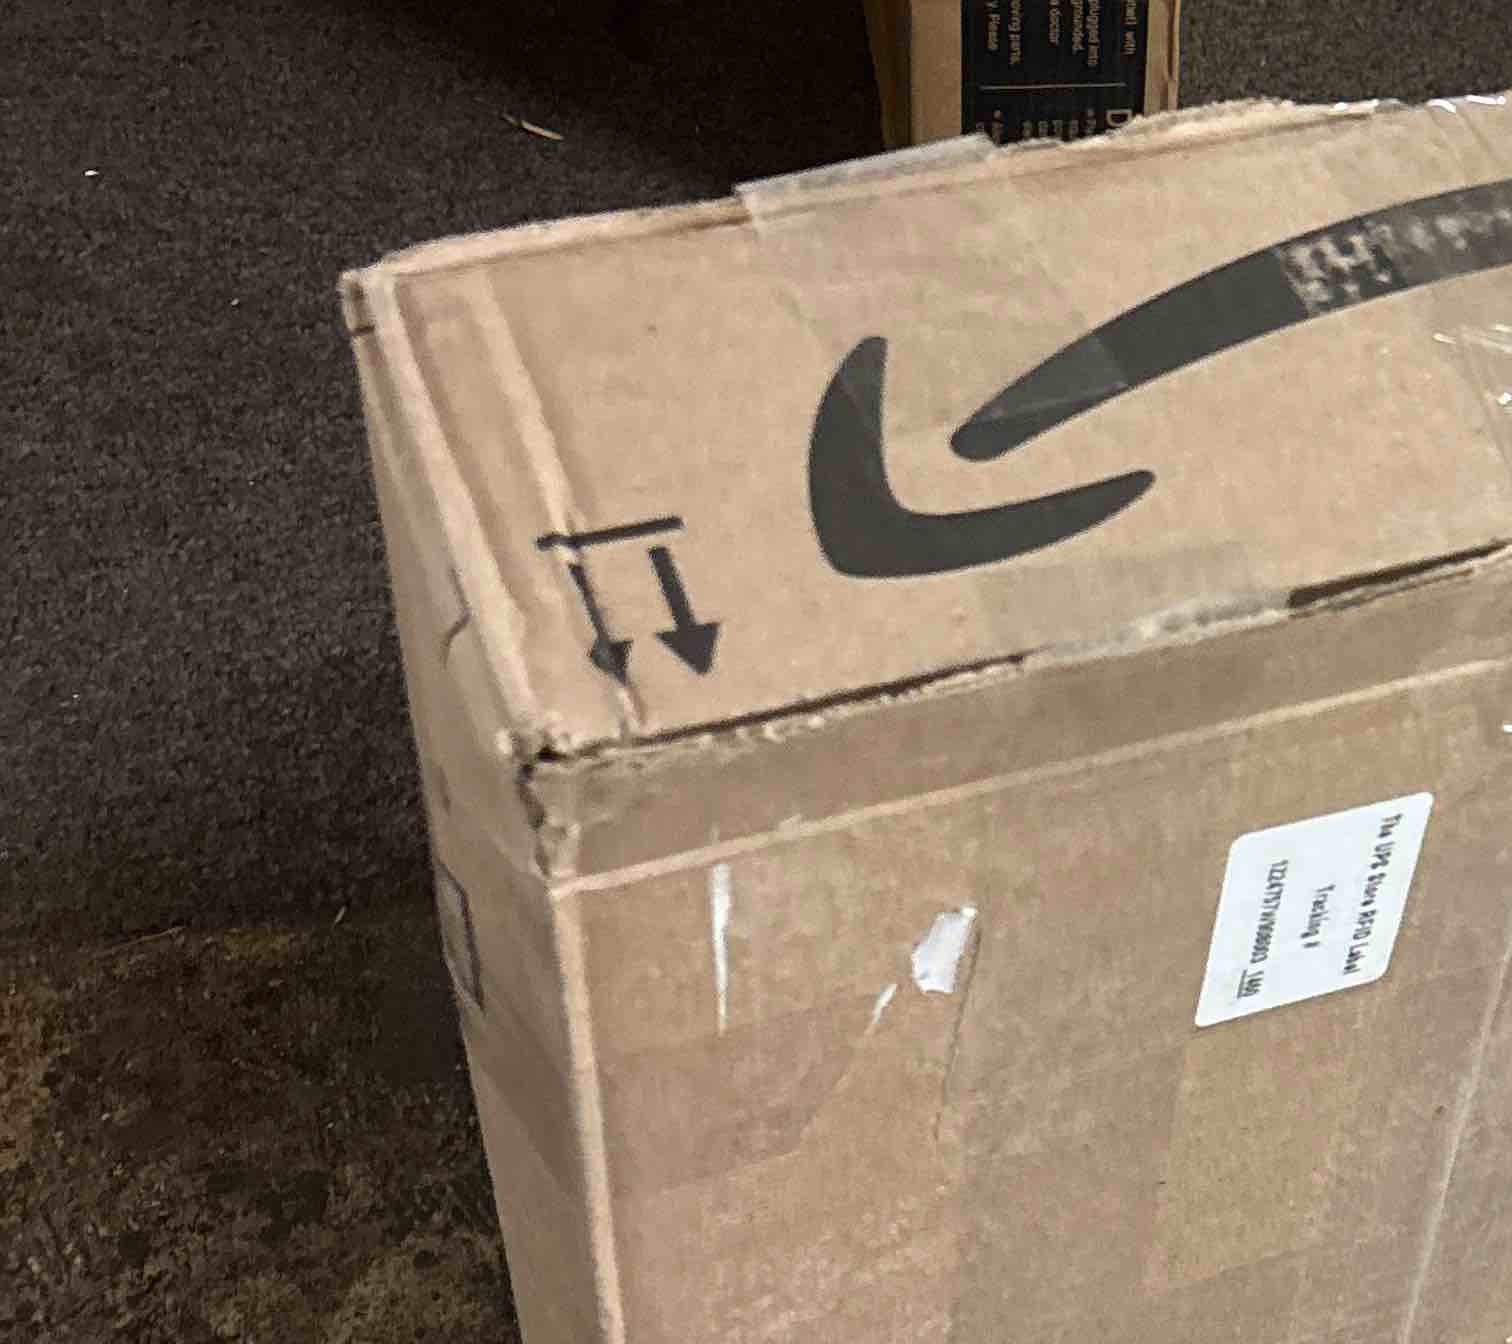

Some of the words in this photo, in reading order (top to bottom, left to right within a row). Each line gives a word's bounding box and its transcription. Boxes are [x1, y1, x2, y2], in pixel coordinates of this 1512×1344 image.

[987, 14, 1000, 50] Please
[1049, 8, 1060, 45] doctor
[1085, 0, 1099, 42] plugged
[1300, 883, 1335, 939] Tracking
[1353, 908, 1378, 941] RFID
